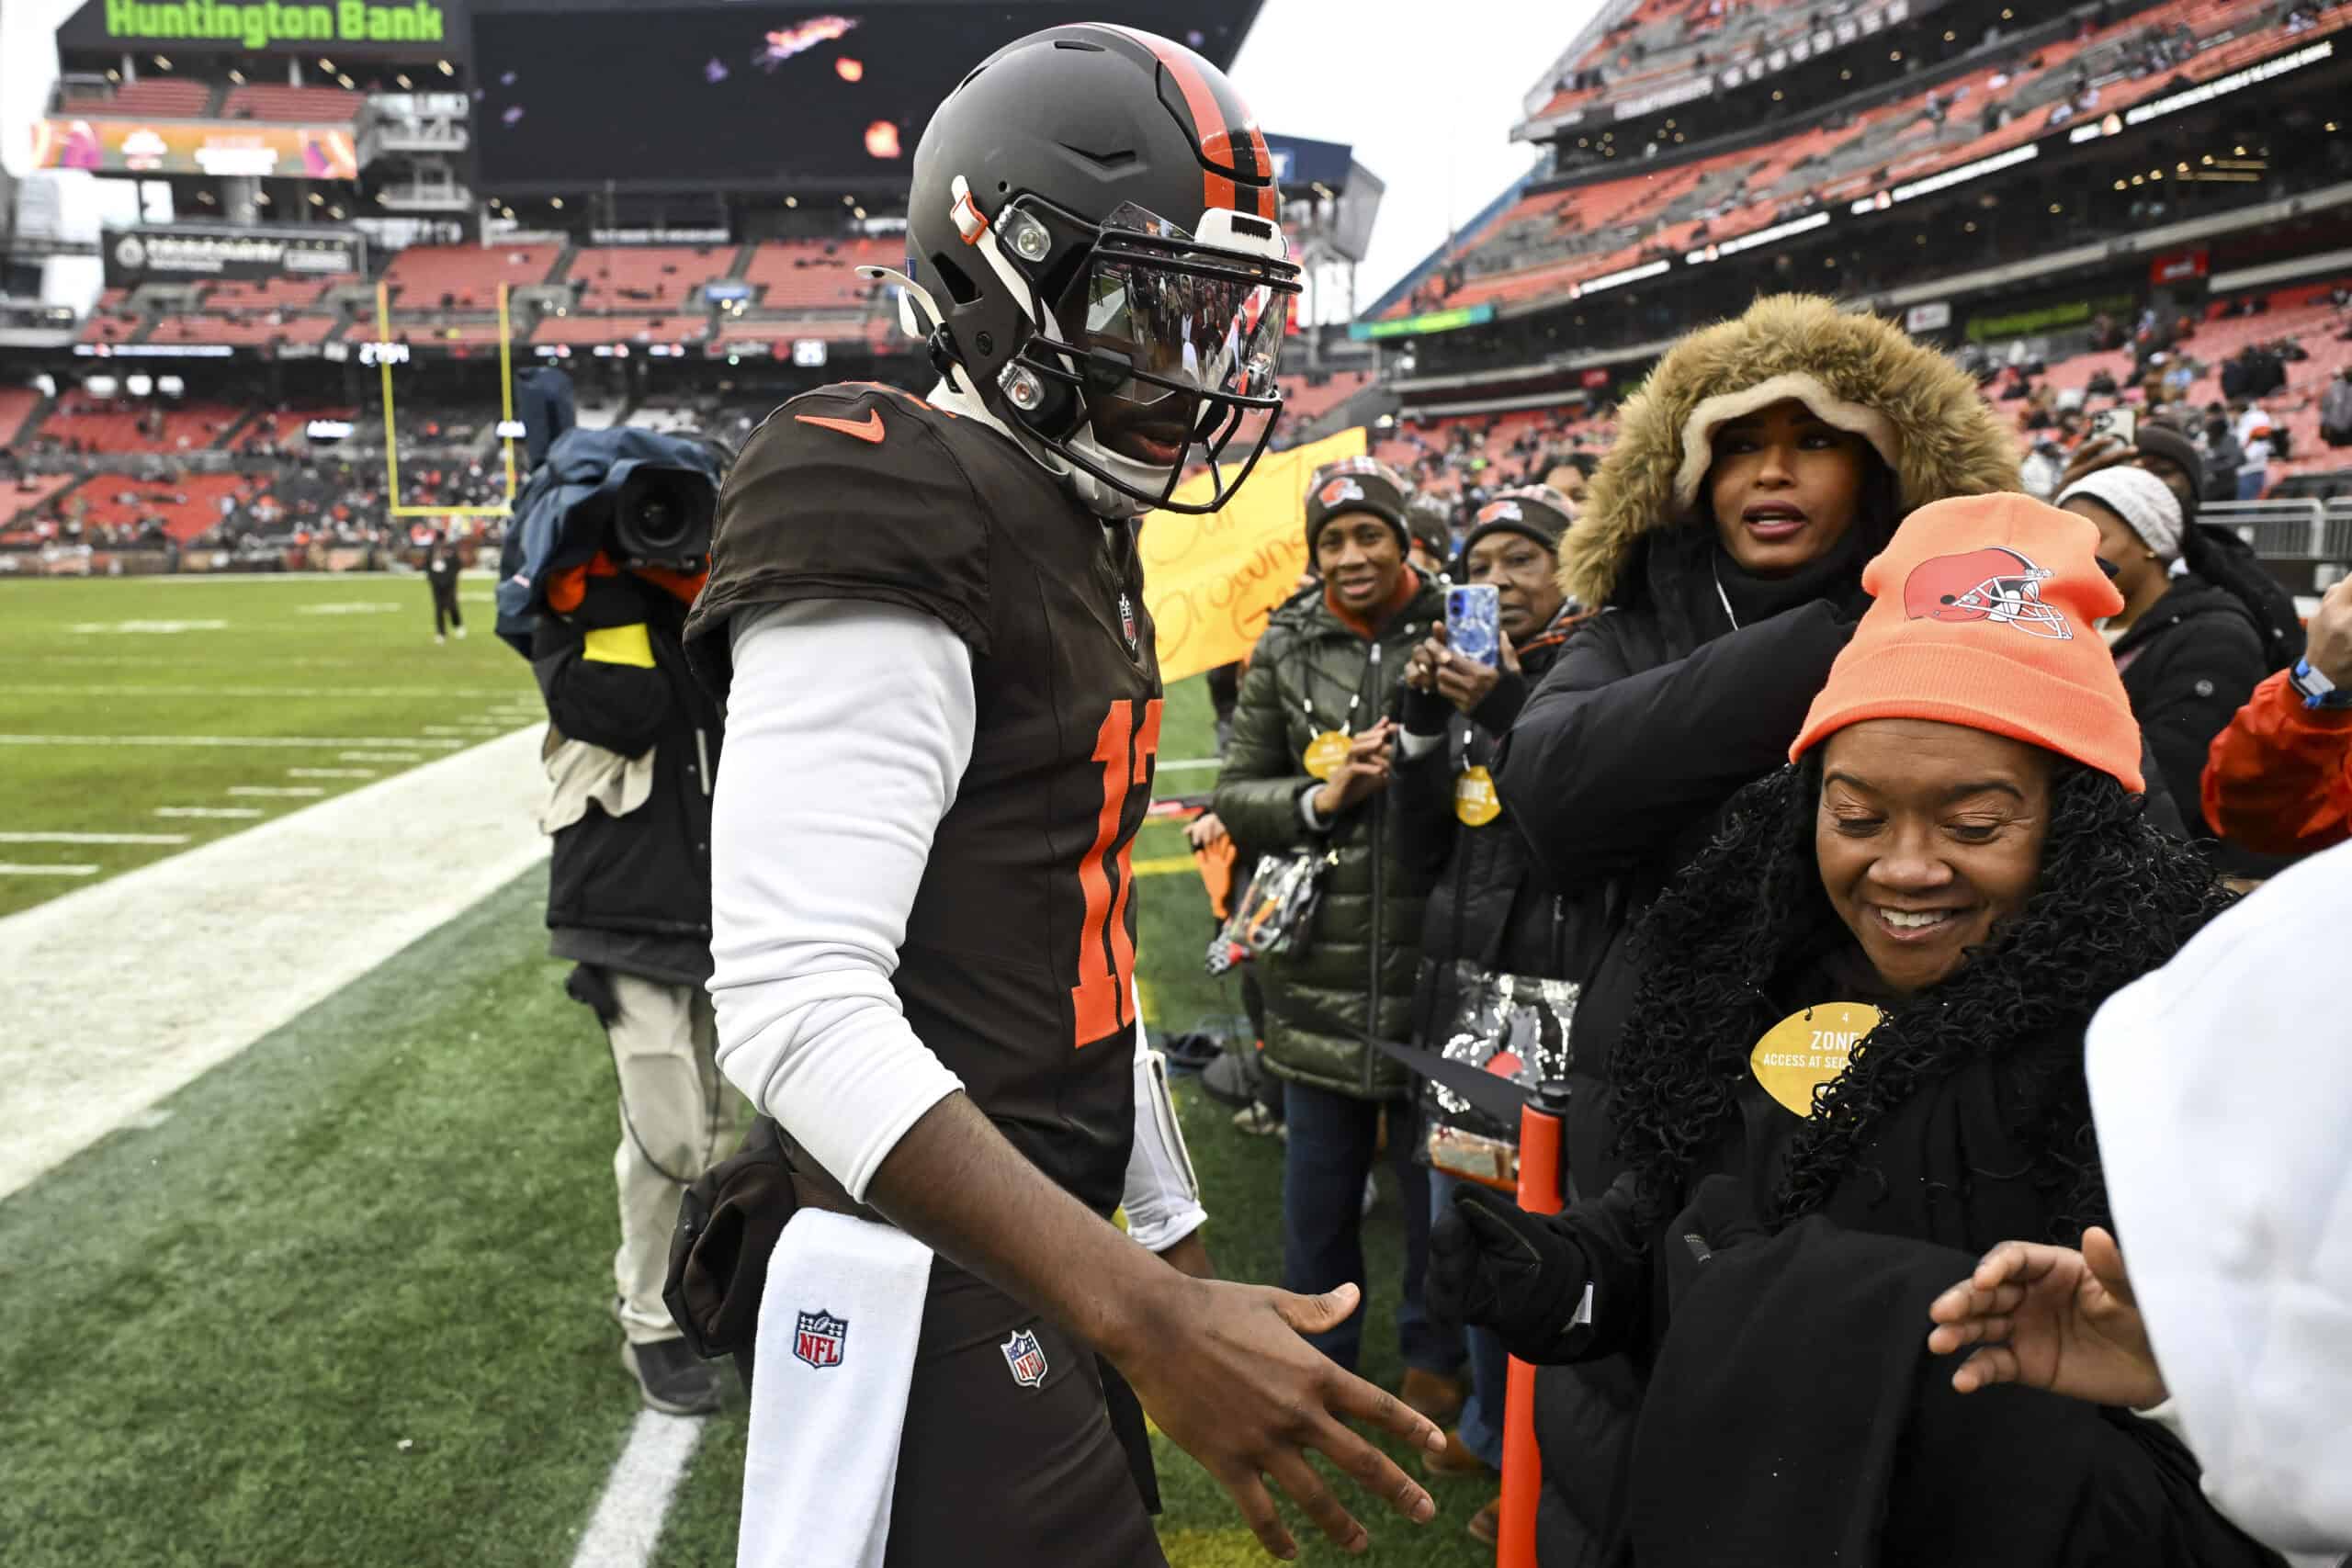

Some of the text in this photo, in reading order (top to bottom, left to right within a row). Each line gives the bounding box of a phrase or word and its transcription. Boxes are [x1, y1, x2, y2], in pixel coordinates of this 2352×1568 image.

[105, 0, 444, 49] Huntington Bank
[1763, 1052, 1848, 1072] ACCESS AT SEC
[797, 1331, 840, 1365] NFL
[1015, 1351, 1046, 1380] NFL
